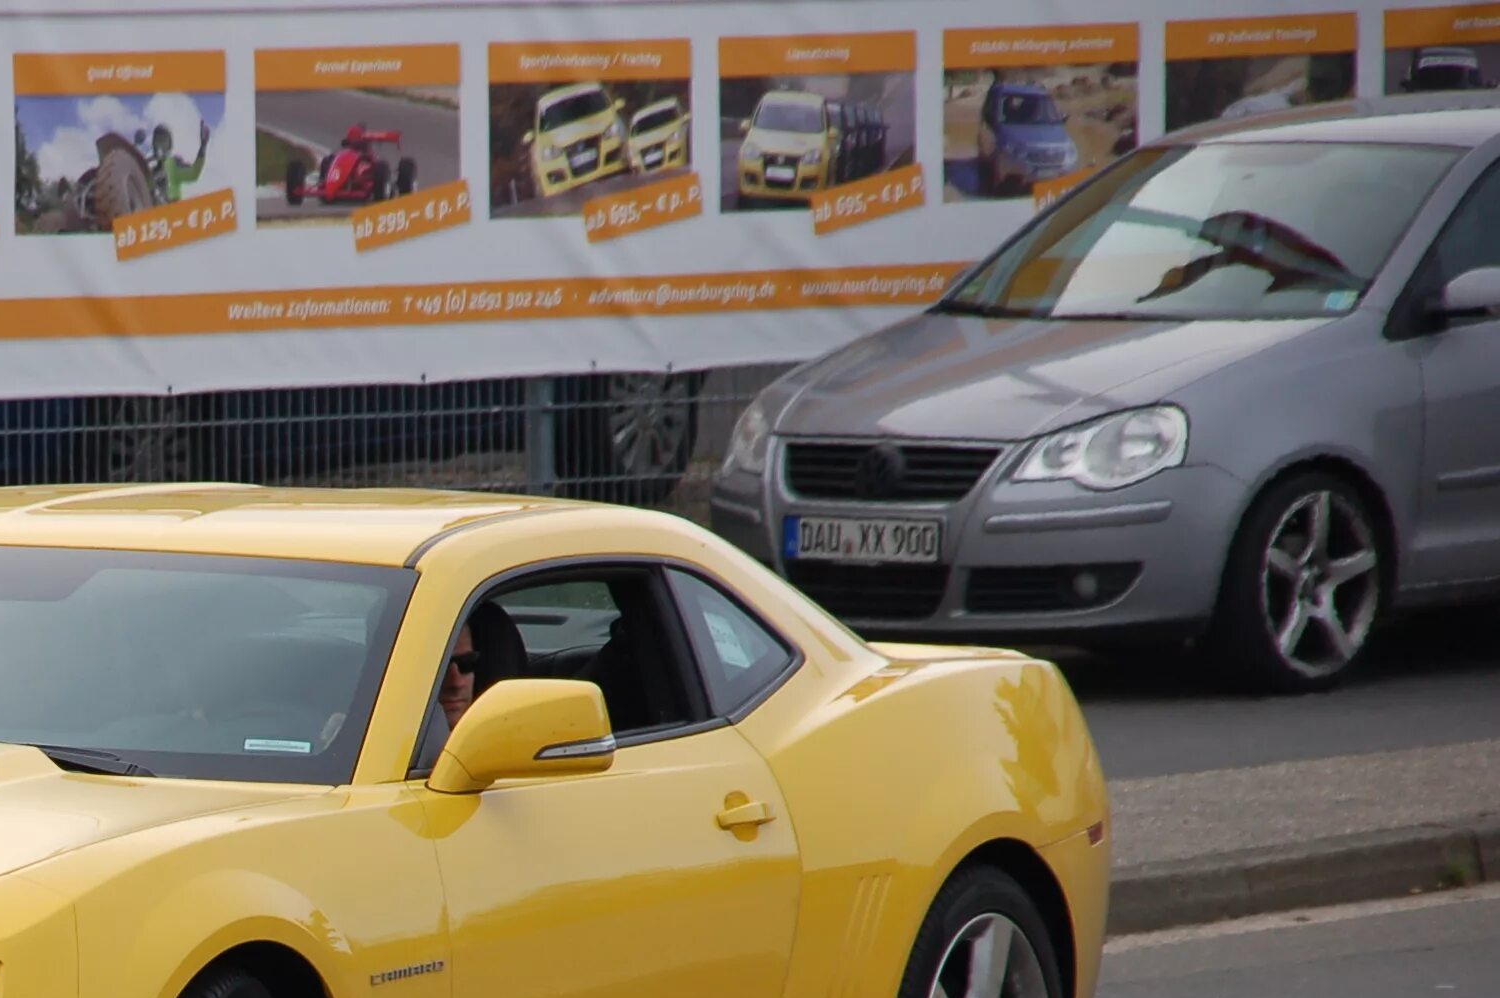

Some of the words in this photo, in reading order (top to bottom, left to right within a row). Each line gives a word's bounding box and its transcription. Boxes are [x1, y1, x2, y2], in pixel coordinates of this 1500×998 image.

[117, 225, 136, 248] ab
[355, 217, 373, 239] ab
[228, 304, 283, 320] Weitere
[287, 299, 392, 321] Informationen:
[800, 521, 842, 553] DAU
[859, 523, 887, 555] XX
[892, 525, 937, 556] 900
